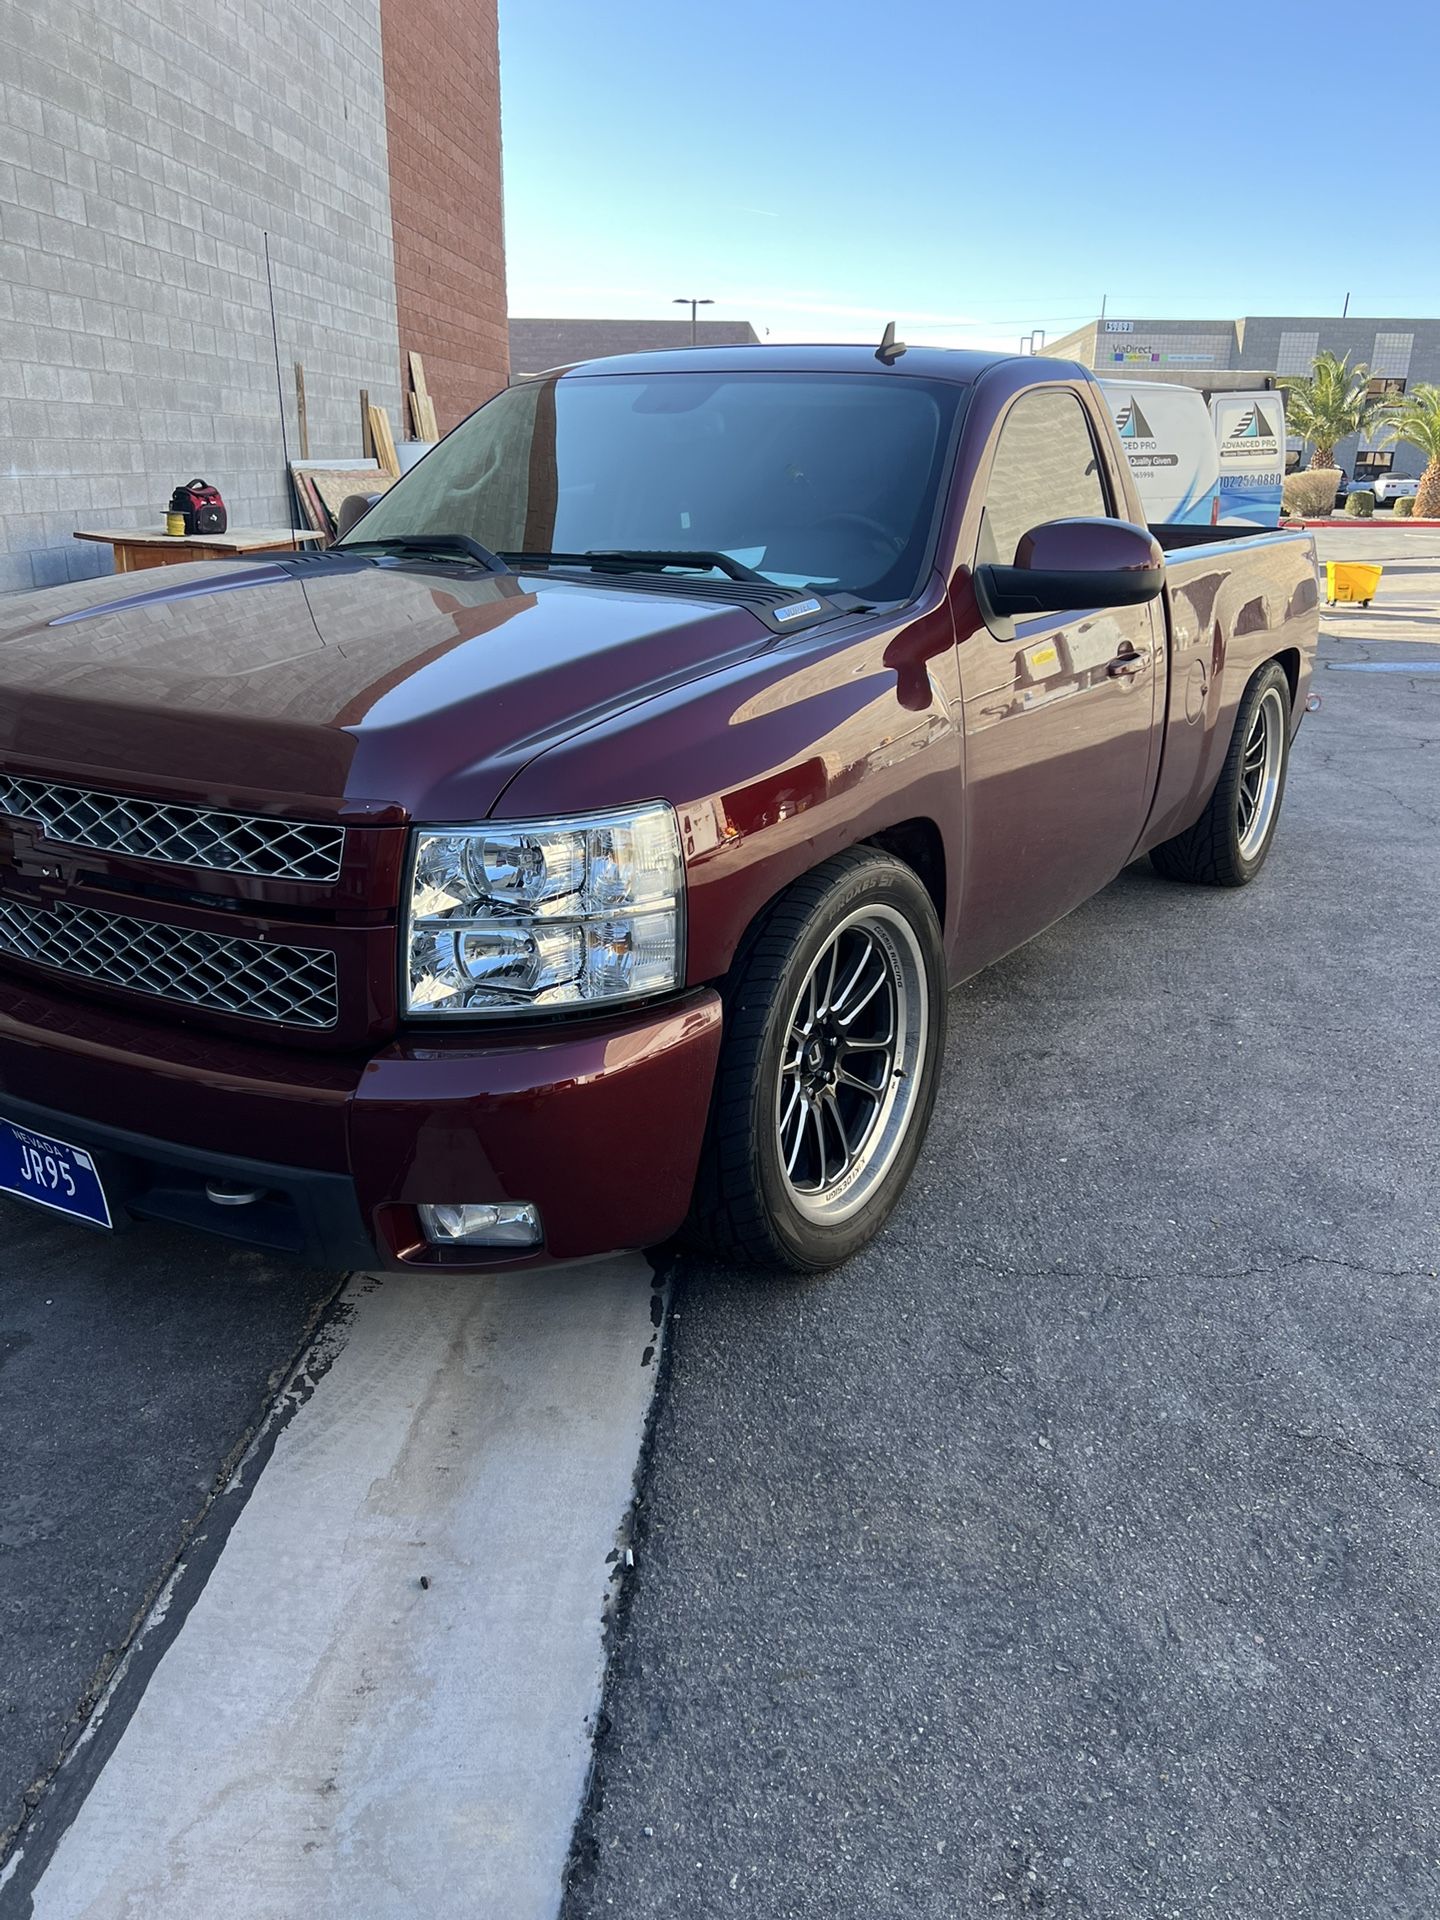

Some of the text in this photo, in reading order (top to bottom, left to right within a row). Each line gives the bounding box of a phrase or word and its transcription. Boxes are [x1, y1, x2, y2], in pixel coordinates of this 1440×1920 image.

[1113, 344, 1152, 354] ViaDirect
[1140, 441, 1157, 450] PRO
[1221, 439, 1277, 449] ADVANCED PRO
[1129, 456, 1172, 466] Quality Given
[828, 878, 877, 922] PROXES
[873, 926, 904, 988] COSMIS RACING
[12, 1128, 63, 1158] NEVADA
[21, 1145, 76, 1196] JR95
[825, 1175, 853, 1202] DESIGN
